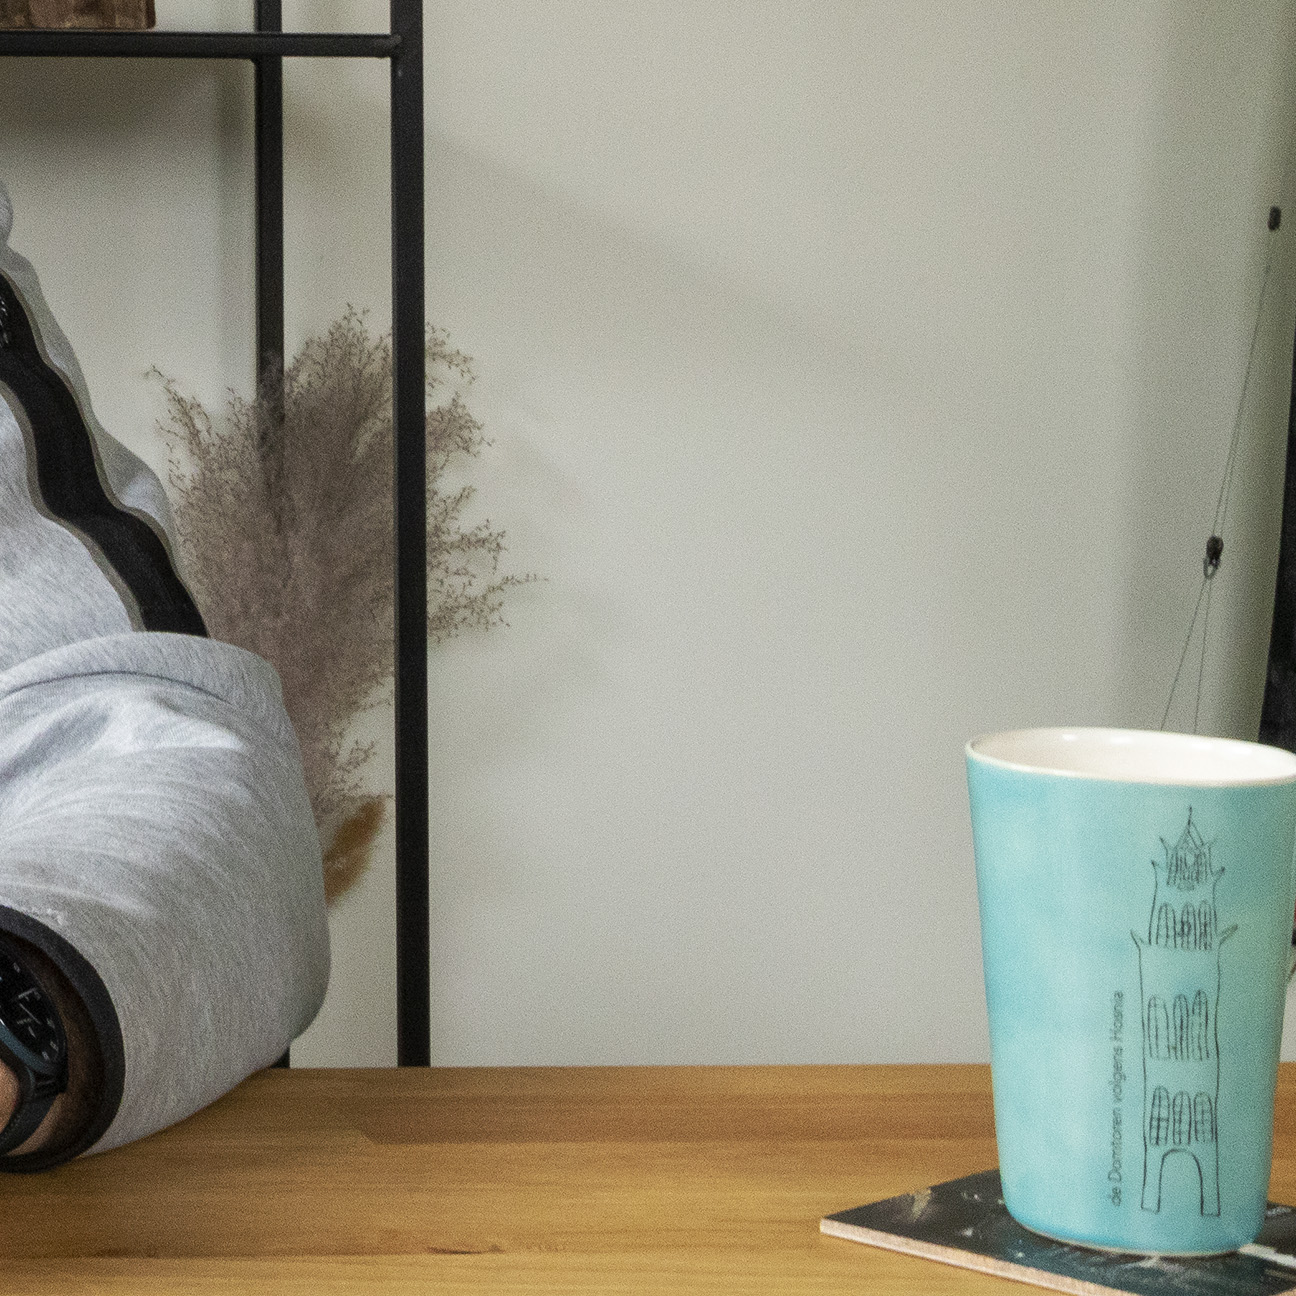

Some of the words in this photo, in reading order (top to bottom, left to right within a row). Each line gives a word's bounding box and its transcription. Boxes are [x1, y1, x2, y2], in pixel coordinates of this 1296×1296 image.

[1109, 1045, 1126, 1103] volgens
[1108, 1106, 1122, 1183] Domtoren
[1109, 1186, 1122, 1207] de
